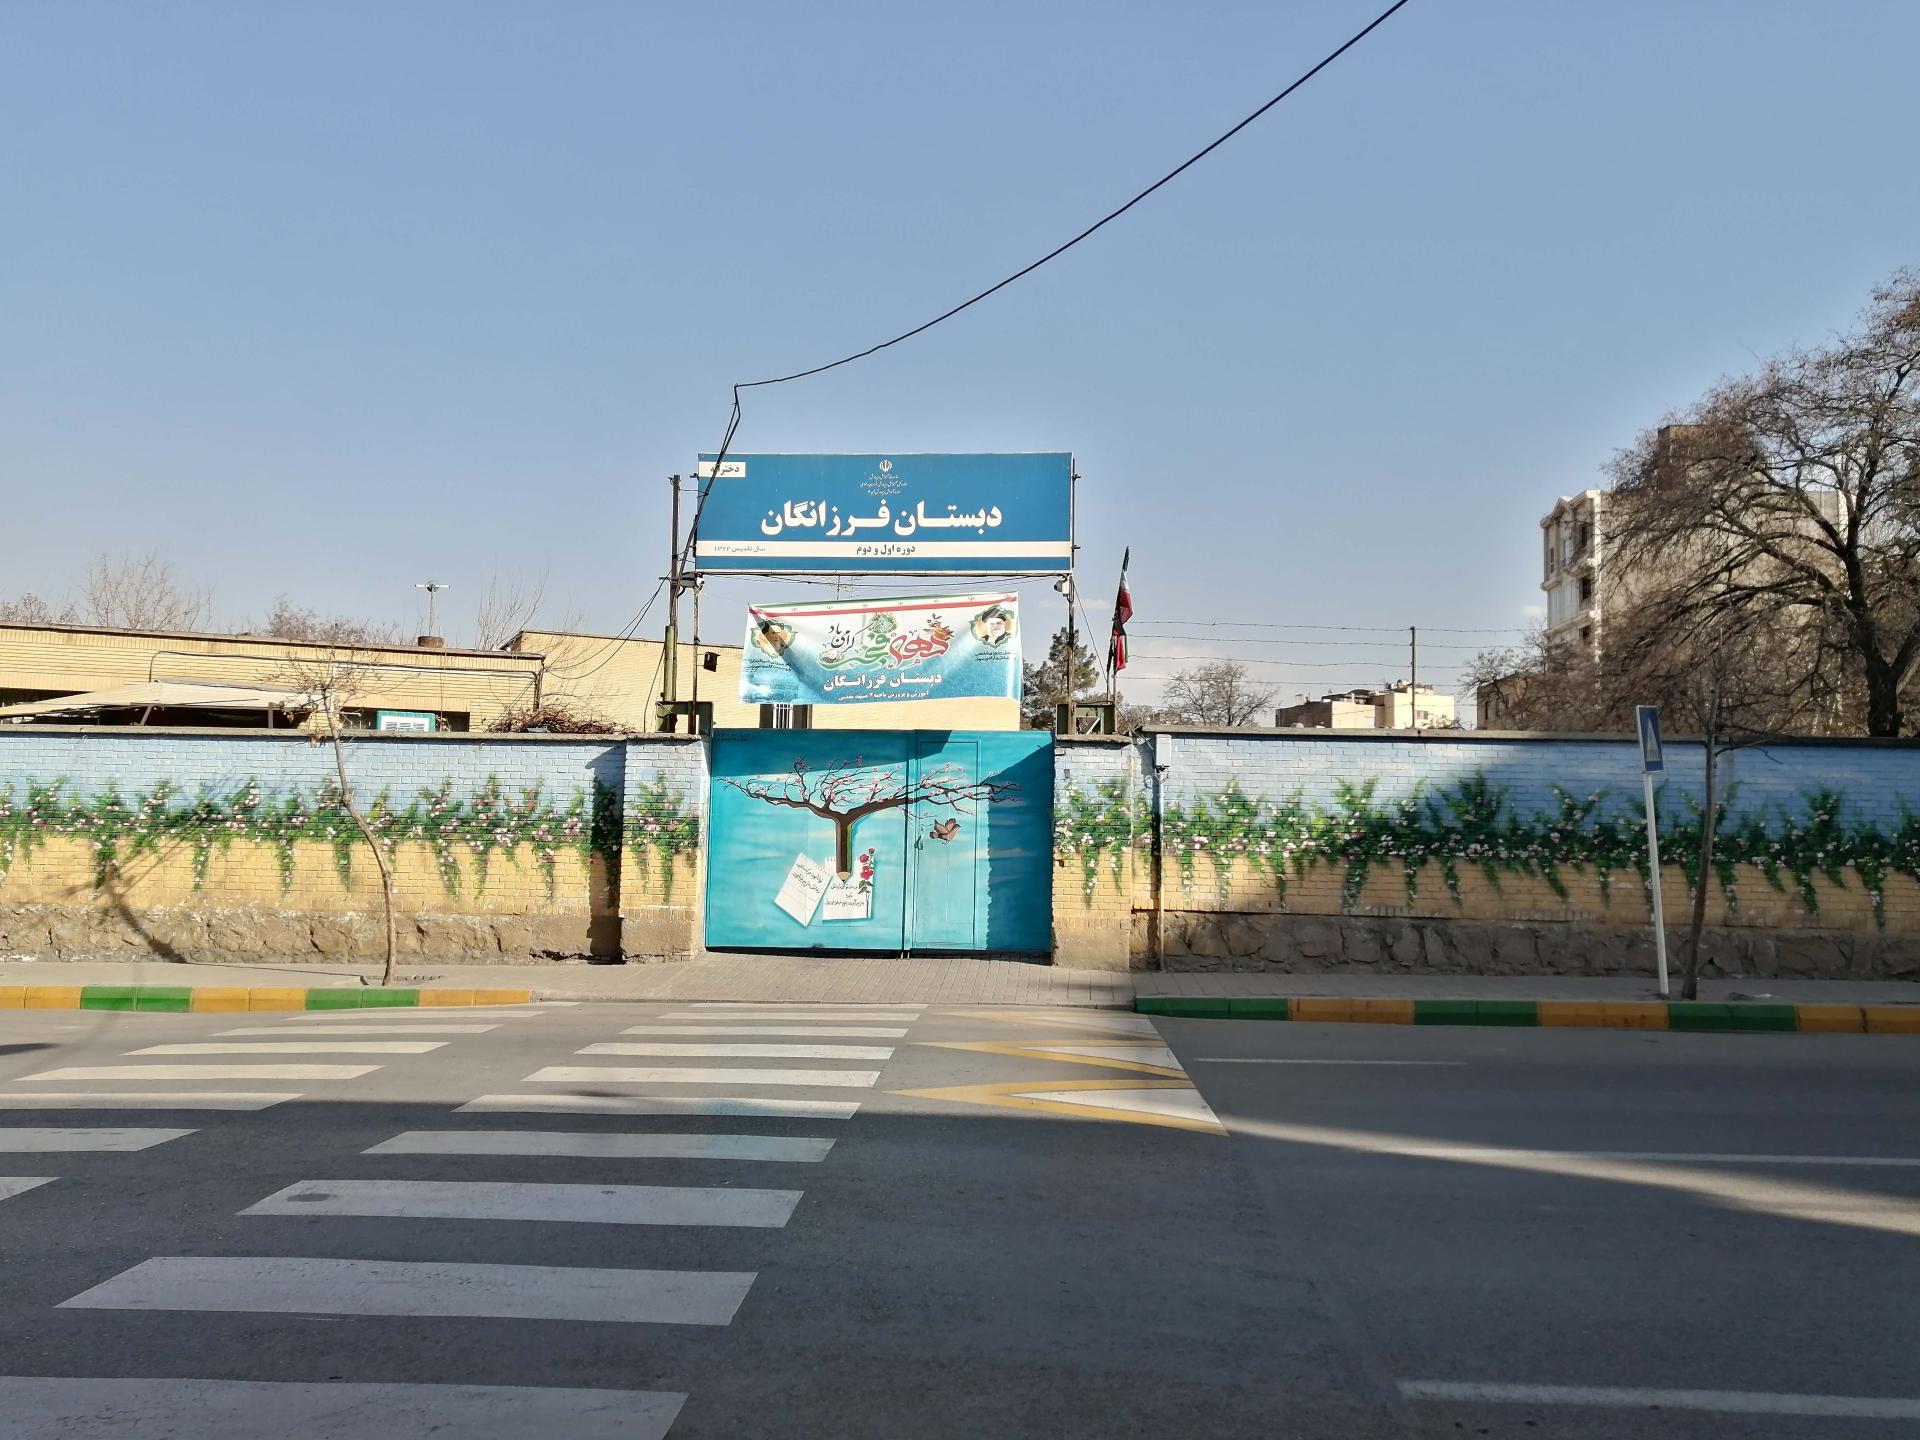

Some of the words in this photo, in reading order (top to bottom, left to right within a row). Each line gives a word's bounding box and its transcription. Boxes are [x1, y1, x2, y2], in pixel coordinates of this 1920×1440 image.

[710, 464, 740, 476] دختره
[760, 498, 891, 536] فرزانگان
[894, 500, 1003, 536] دبستان
[856, 545, 872, 556] دوم
[880, 544, 895, 555] اول
[896, 545, 916, 555] دوره
[822, 671, 887, 692] فرزانگان
[889, 671, 942, 687] دبستان
